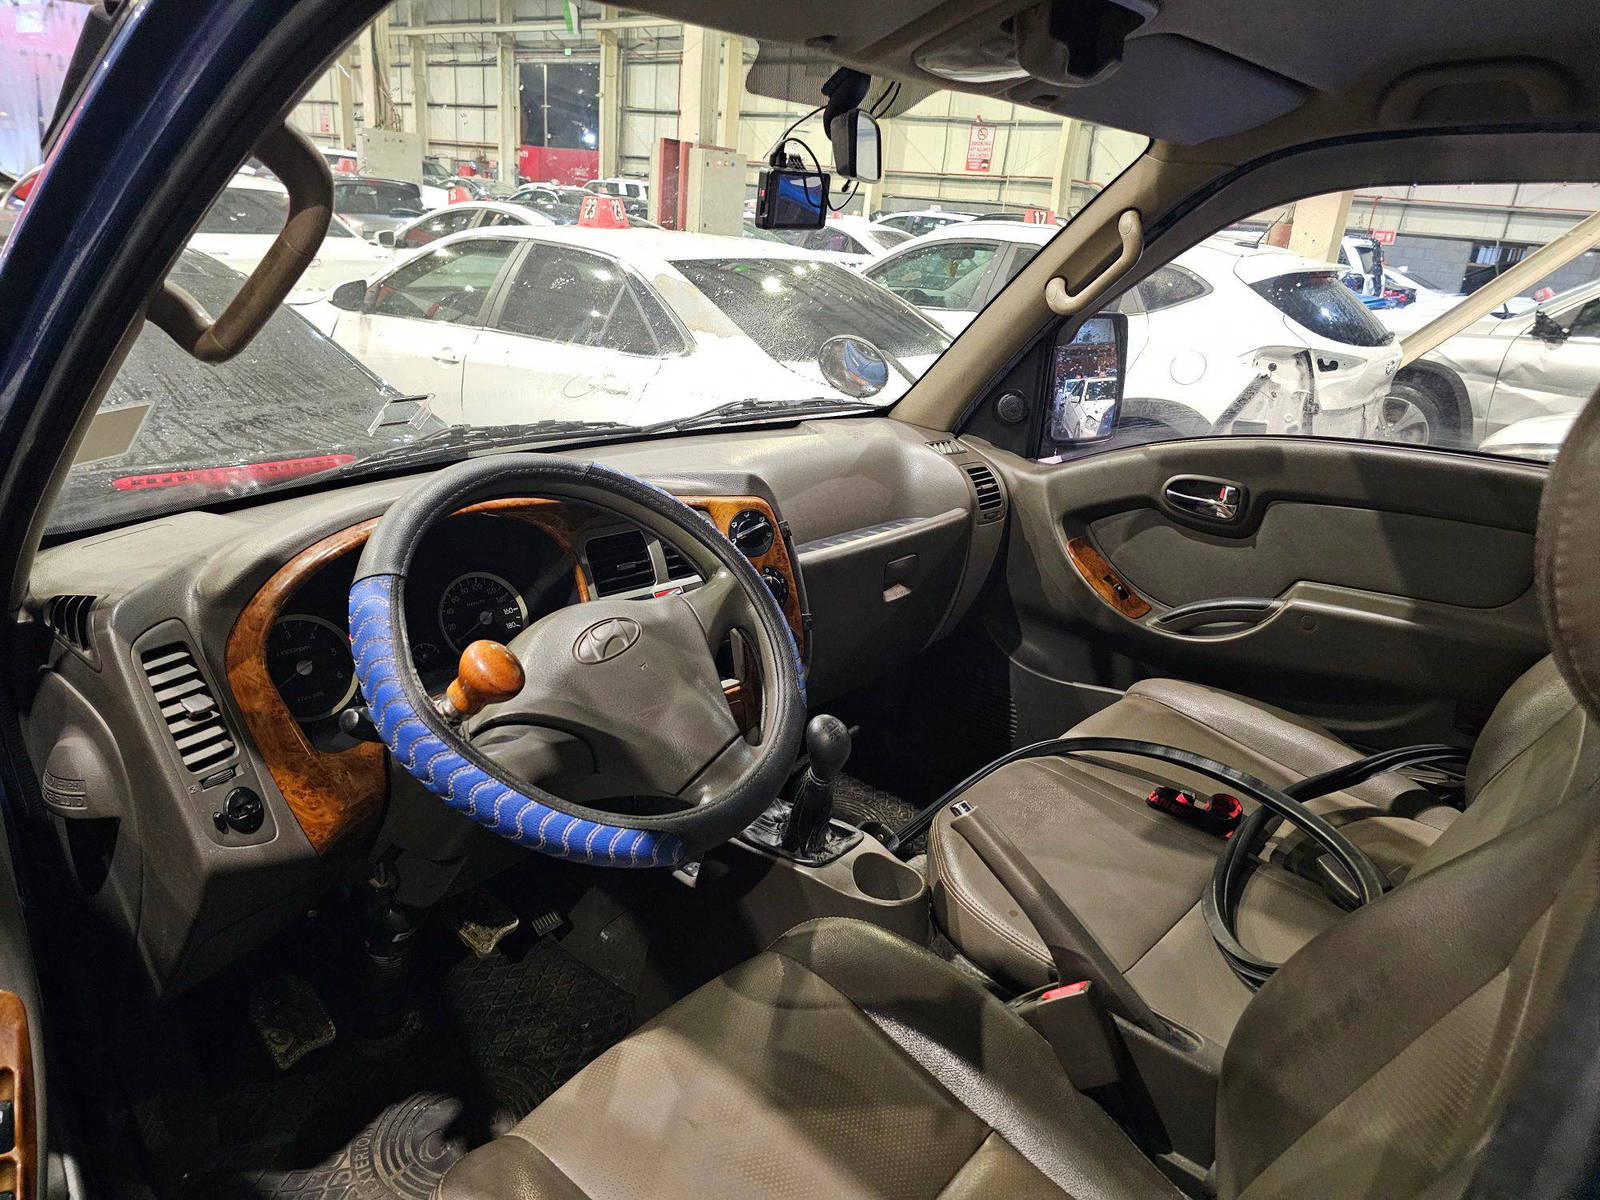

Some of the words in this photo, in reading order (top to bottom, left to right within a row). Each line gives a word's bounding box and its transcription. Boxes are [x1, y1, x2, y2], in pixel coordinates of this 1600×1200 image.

[583, 198, 599, 219] 23
[1034, 211, 1047, 224] 17
[503, 607, 513, 615] 160
[506, 621, 516, 629] 180
